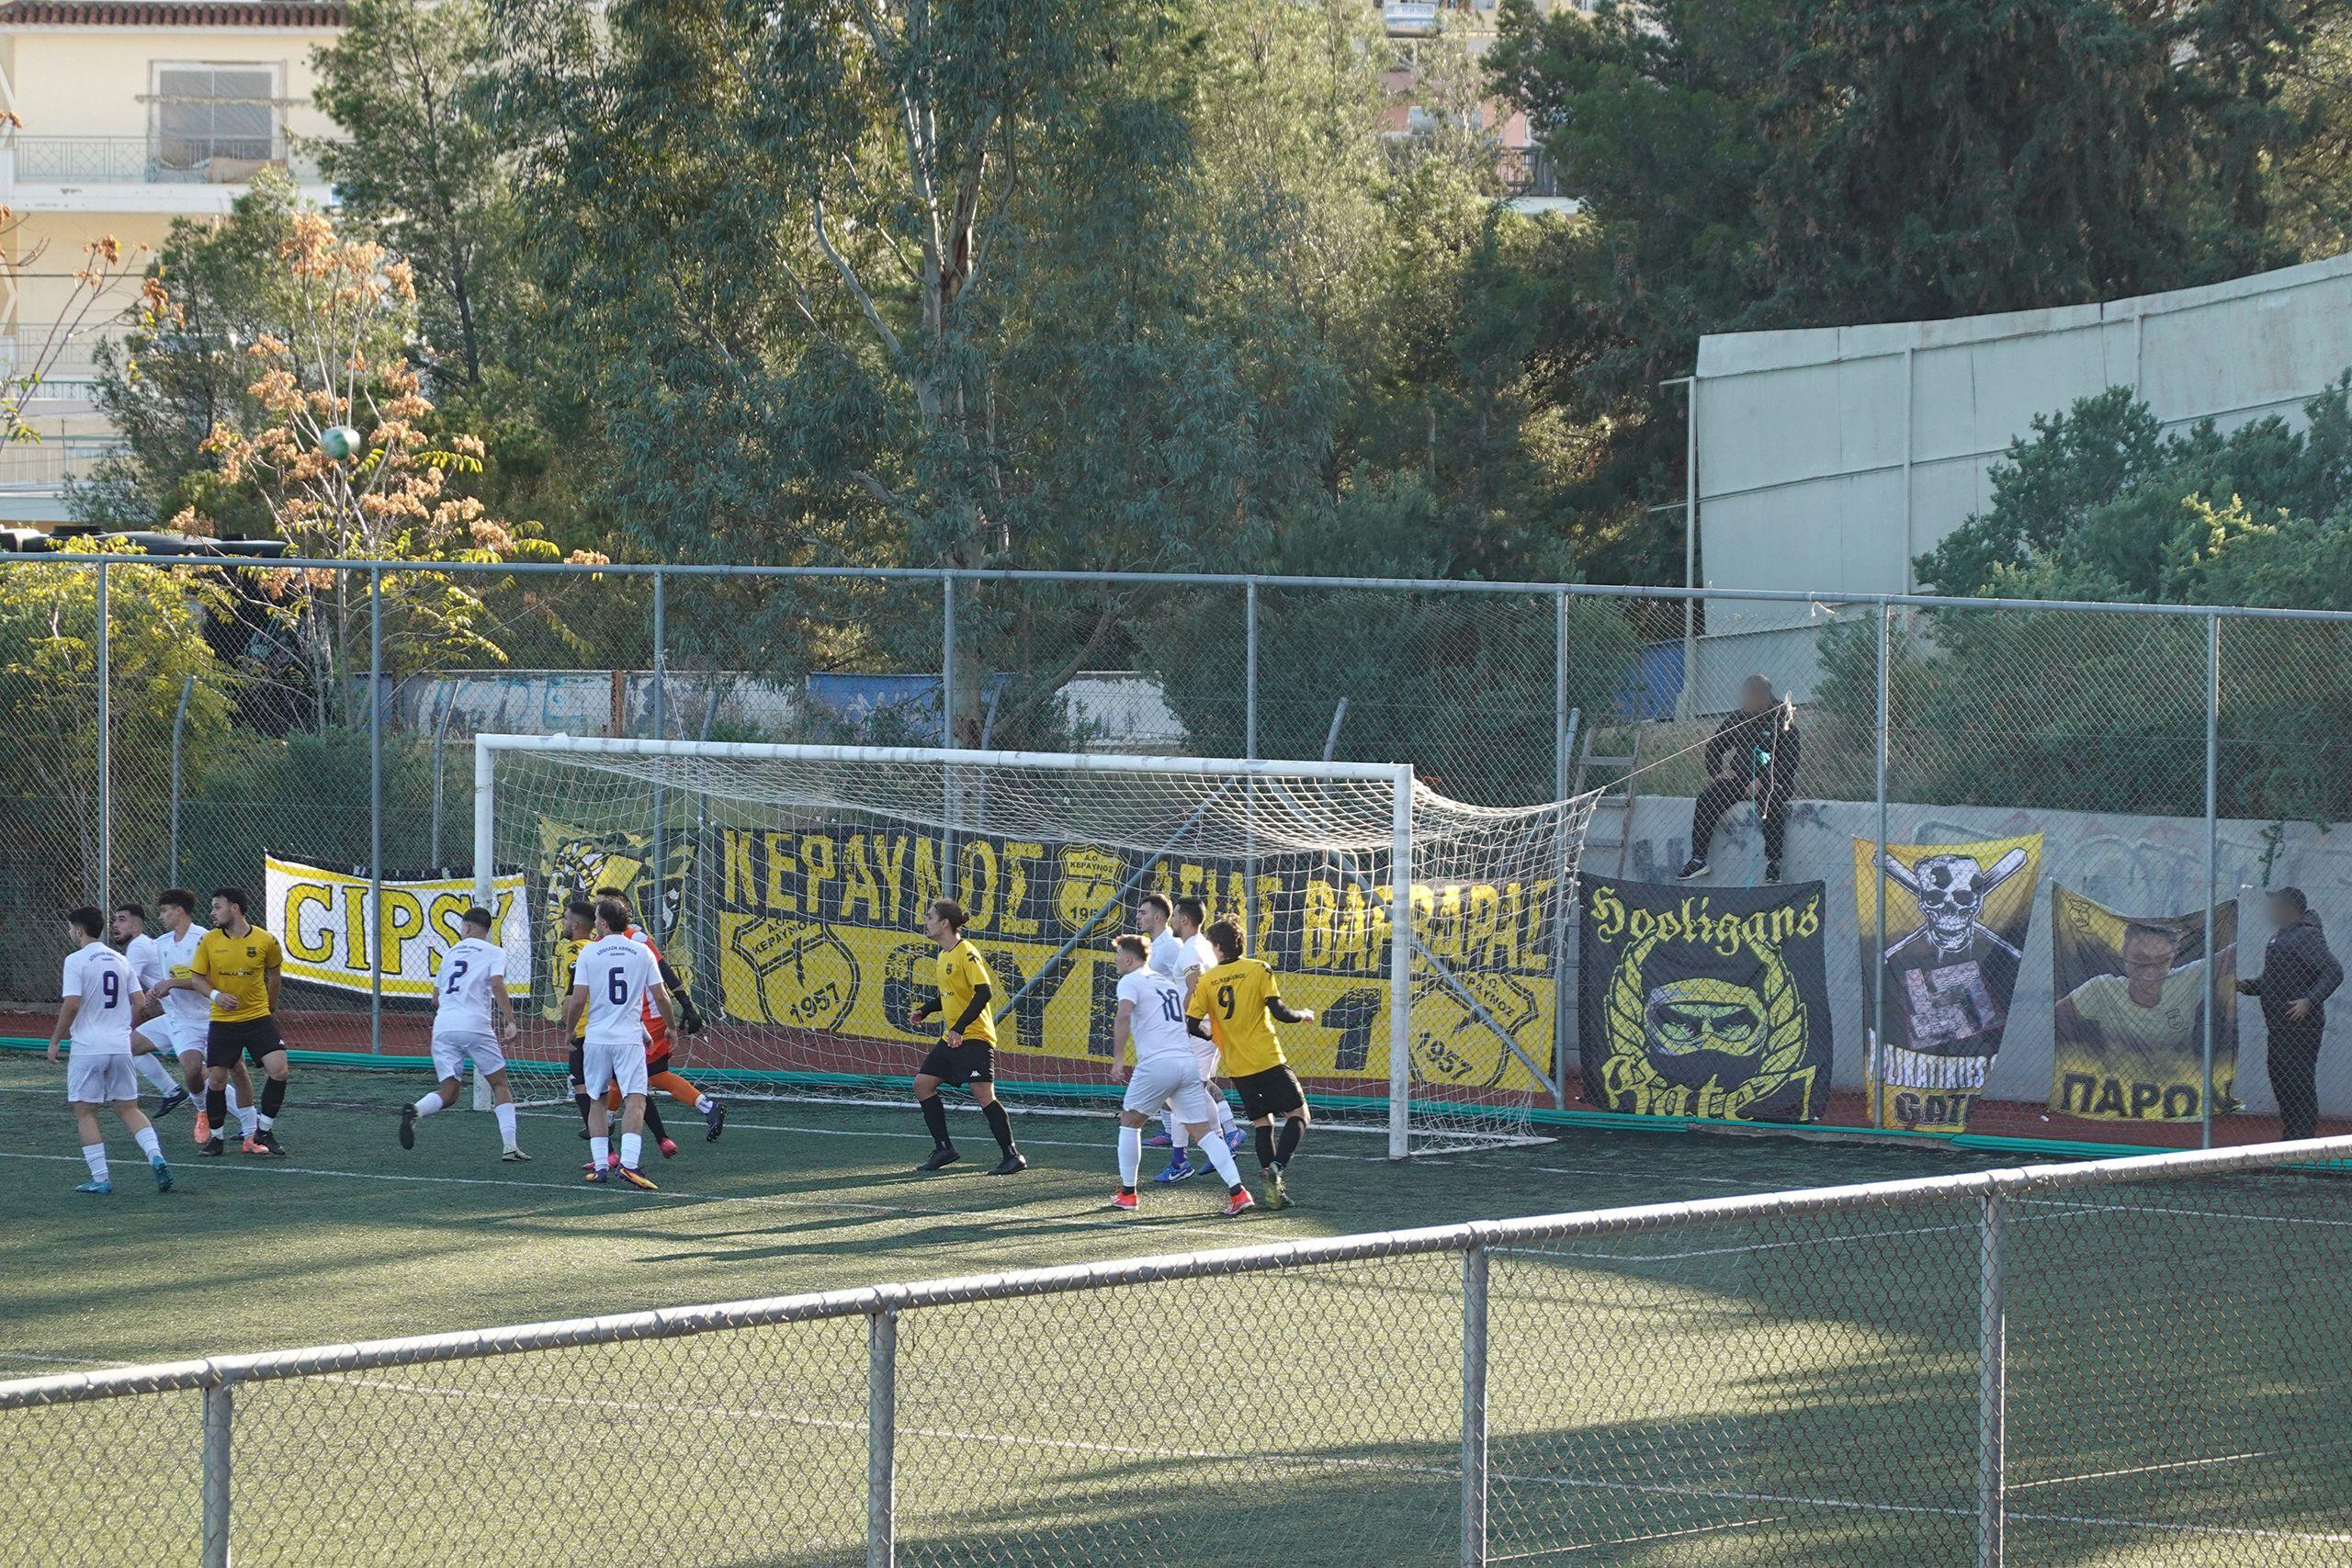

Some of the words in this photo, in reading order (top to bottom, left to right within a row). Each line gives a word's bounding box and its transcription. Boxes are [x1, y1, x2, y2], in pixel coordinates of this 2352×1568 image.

[1069, 861, 1114, 873] ΚΕΡΑΥΝΟΣ
[1070, 907, 1107, 923] 195
[1590, 886, 1820, 956] Hooligans
[752, 919, 815, 955] ΚΕΡΑΥΝΟ
[103, 970, 119, 1009] 9
[447, 961, 468, 994] 2
[608, 966, 628, 1005] 6
[1460, 972, 1515, 1017] ΕΡΑΥΝΟΣ
[789, 981, 841, 1024] 1957
[1156, 987, 1182, 1022] 10
[1218, 986, 1235, 1020] 9
[1416, 1032, 1473, 1081] 1957
[1790, 1065, 1817, 1121] 7
